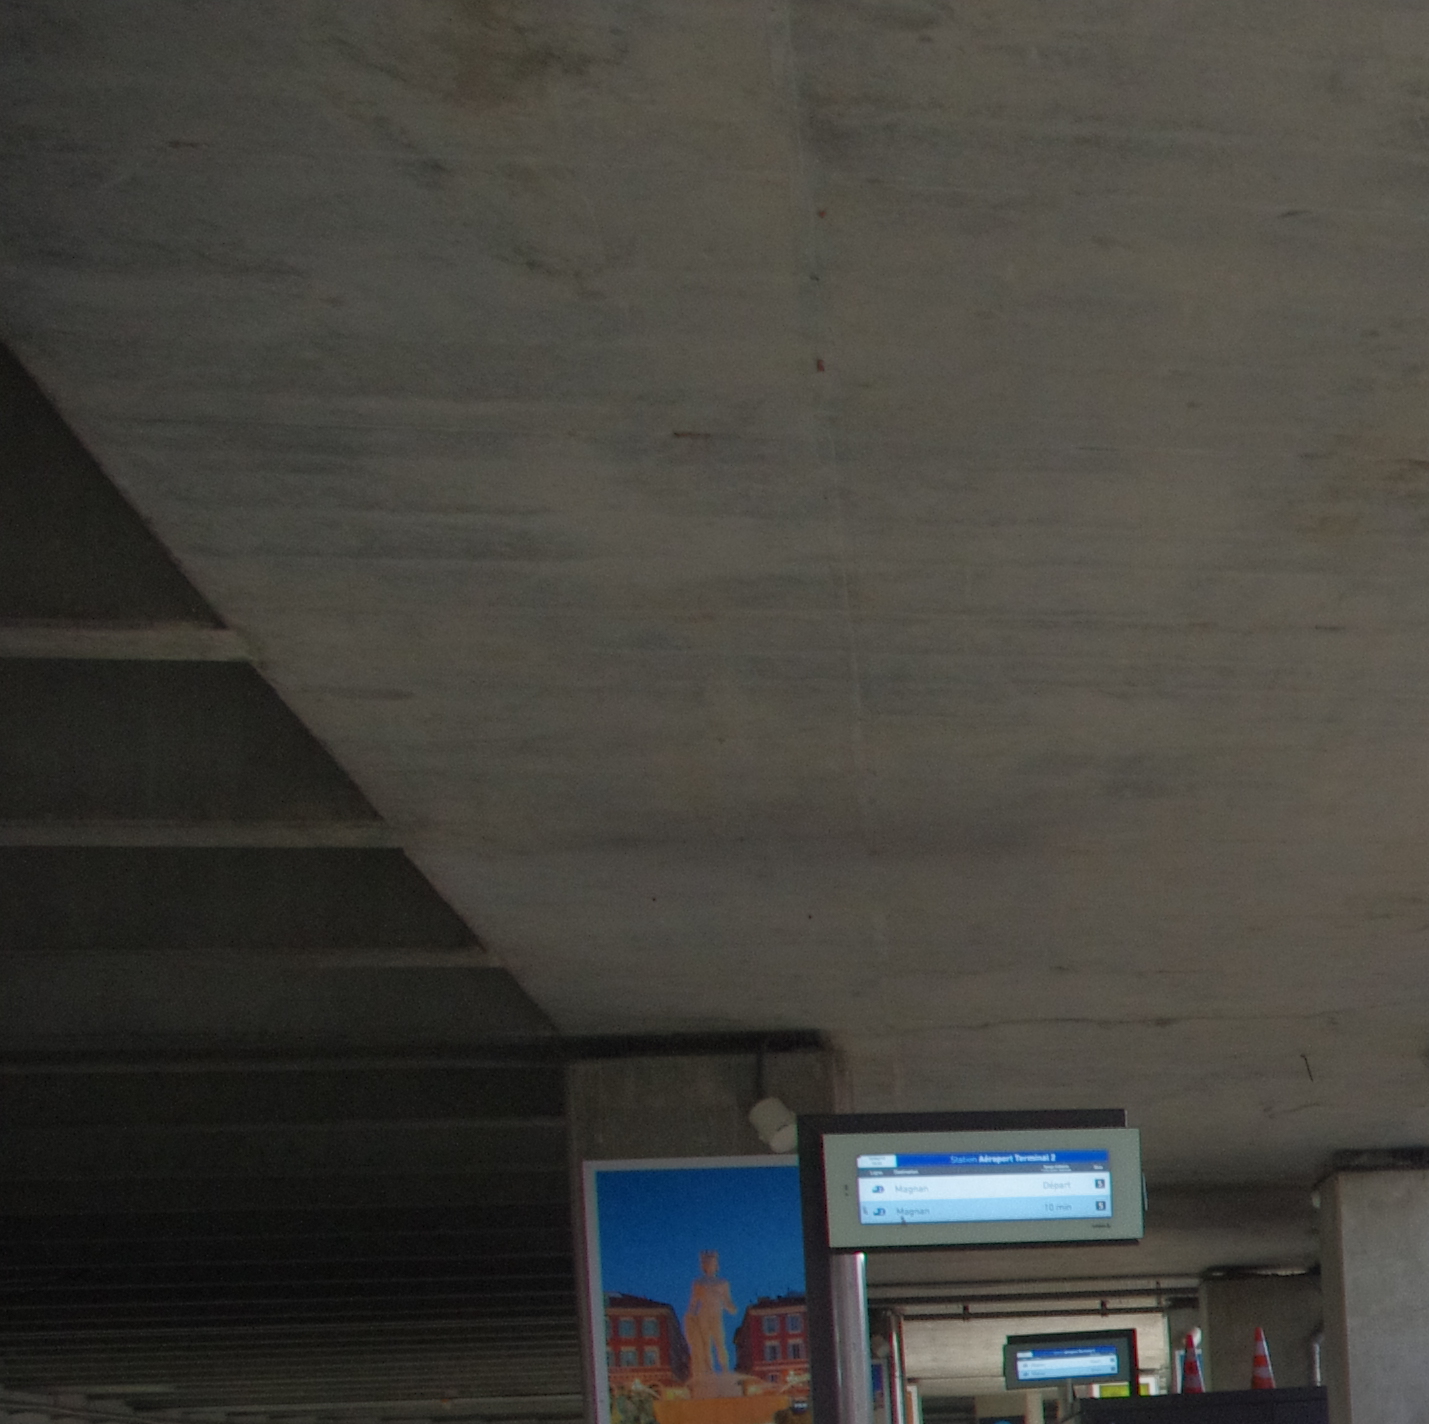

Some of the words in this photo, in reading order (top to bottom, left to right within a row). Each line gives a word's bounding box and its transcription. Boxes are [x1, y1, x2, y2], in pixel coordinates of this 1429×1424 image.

[1014, 1153, 1050, 1162] Terminal
[895, 1185, 929, 1195] Magnan
[1043, 1181, 1071, 1191] Départ
[896, 1208, 930, 1217] Magnan
